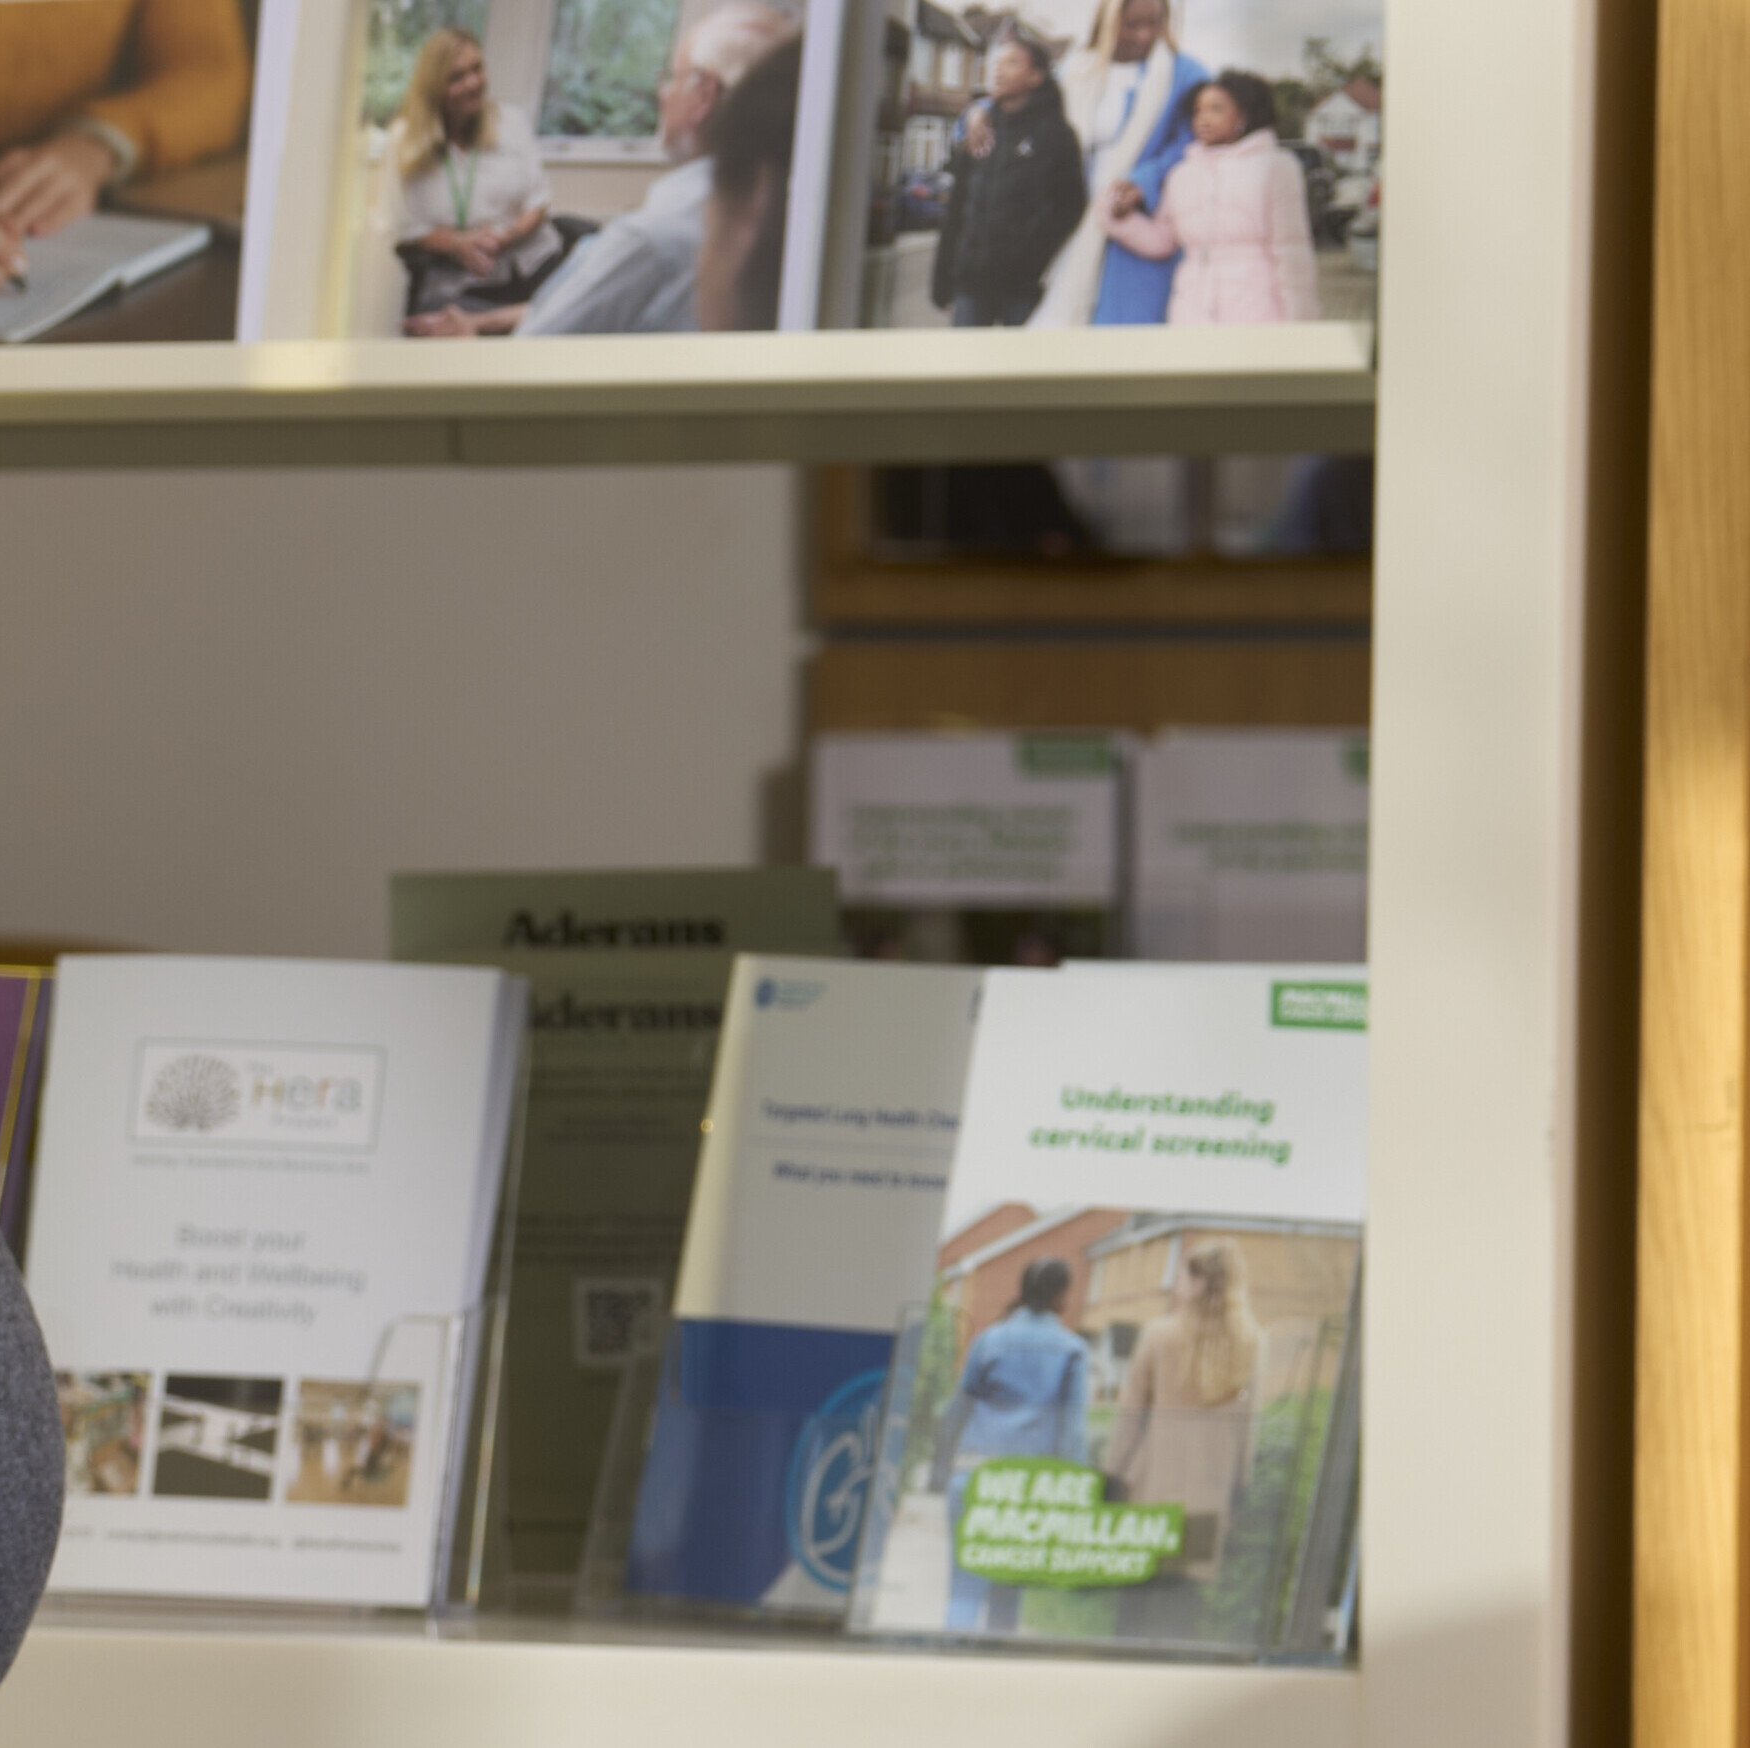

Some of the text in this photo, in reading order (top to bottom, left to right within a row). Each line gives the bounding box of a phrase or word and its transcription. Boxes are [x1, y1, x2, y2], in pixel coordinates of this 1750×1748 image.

[506, 909, 728, 949] Aderans
[252, 1075, 363, 1115] Hera
[1060, 1084, 1275, 1126] Understanding
[1028, 1121, 1292, 1168] cervical screening
[819, 1168, 846, 1191] you
[850, 1167, 886, 1189] need
[195, 1262, 242, 1286] and
[977, 1469, 1097, 1507] WE ARE
[961, 1545, 1151, 1578] CANCER SUPPORT
